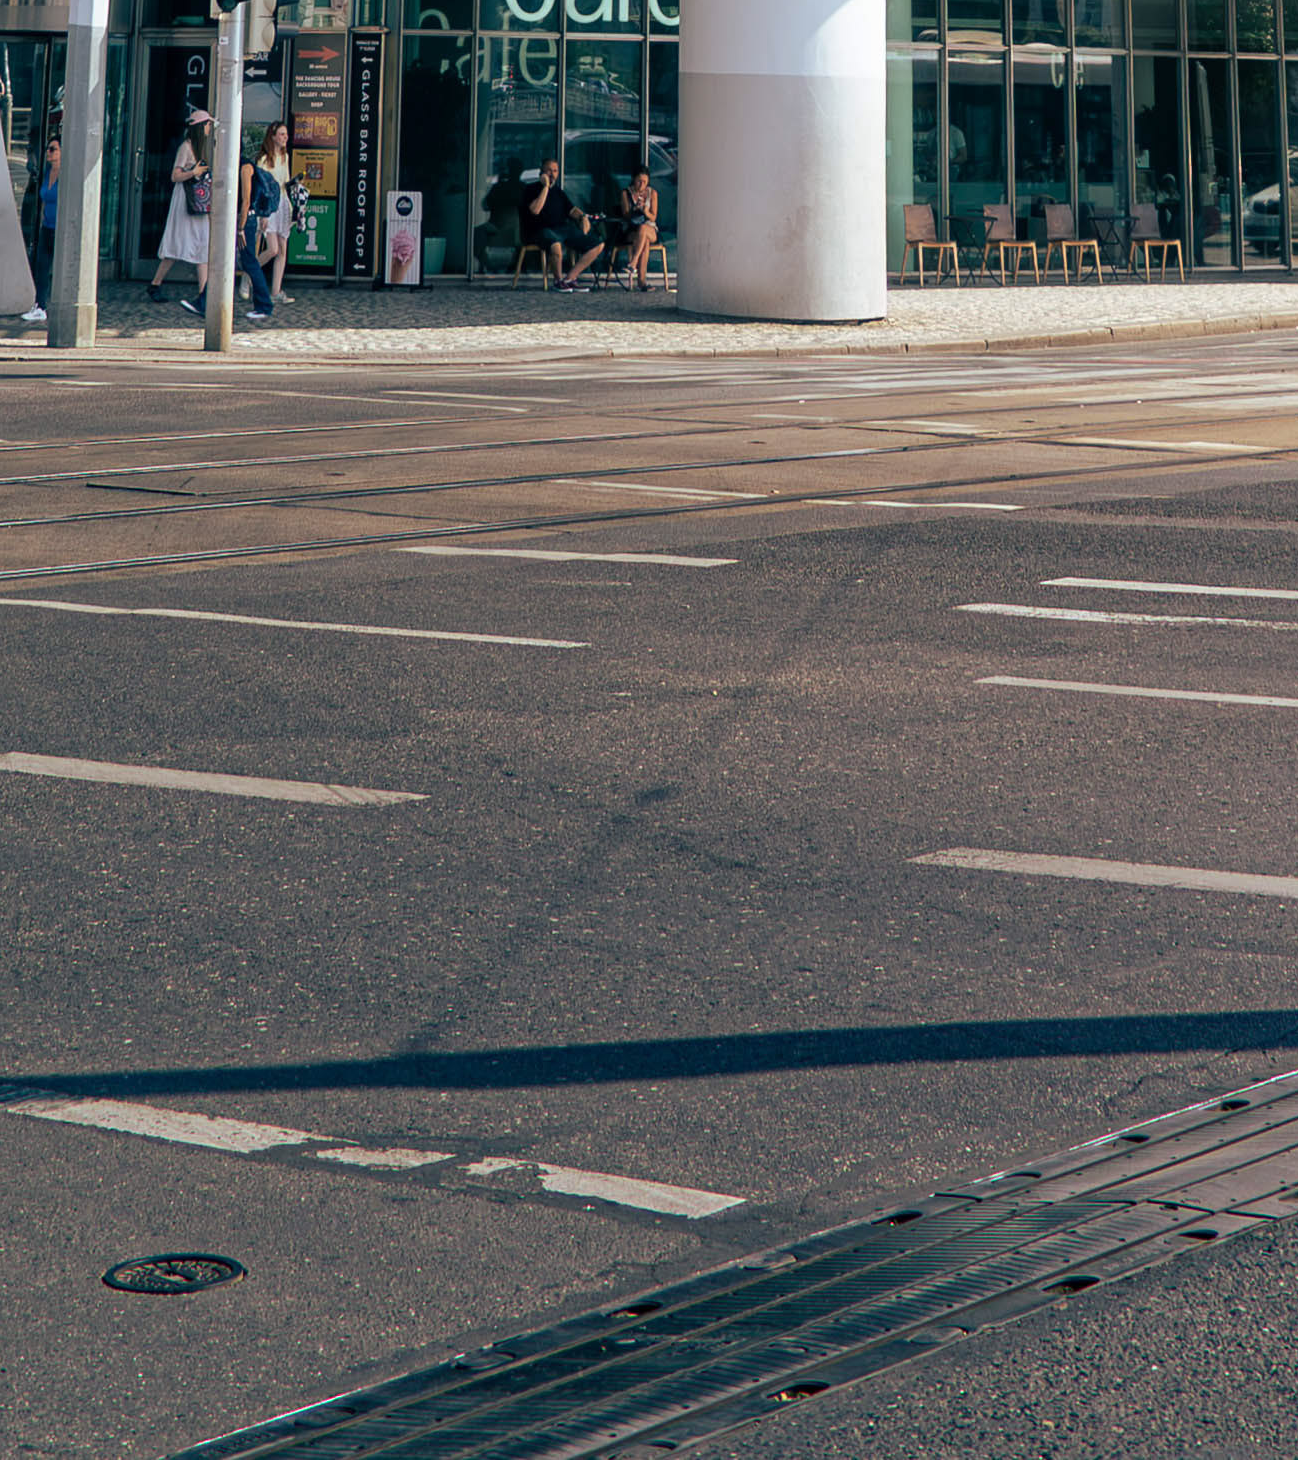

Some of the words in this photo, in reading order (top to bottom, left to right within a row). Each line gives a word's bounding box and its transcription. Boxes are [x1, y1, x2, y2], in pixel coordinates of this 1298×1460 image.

[360, 69, 371, 123] GLASS
[357, 169, 368, 217] ROOF
[355, 223, 365, 258] TOP
